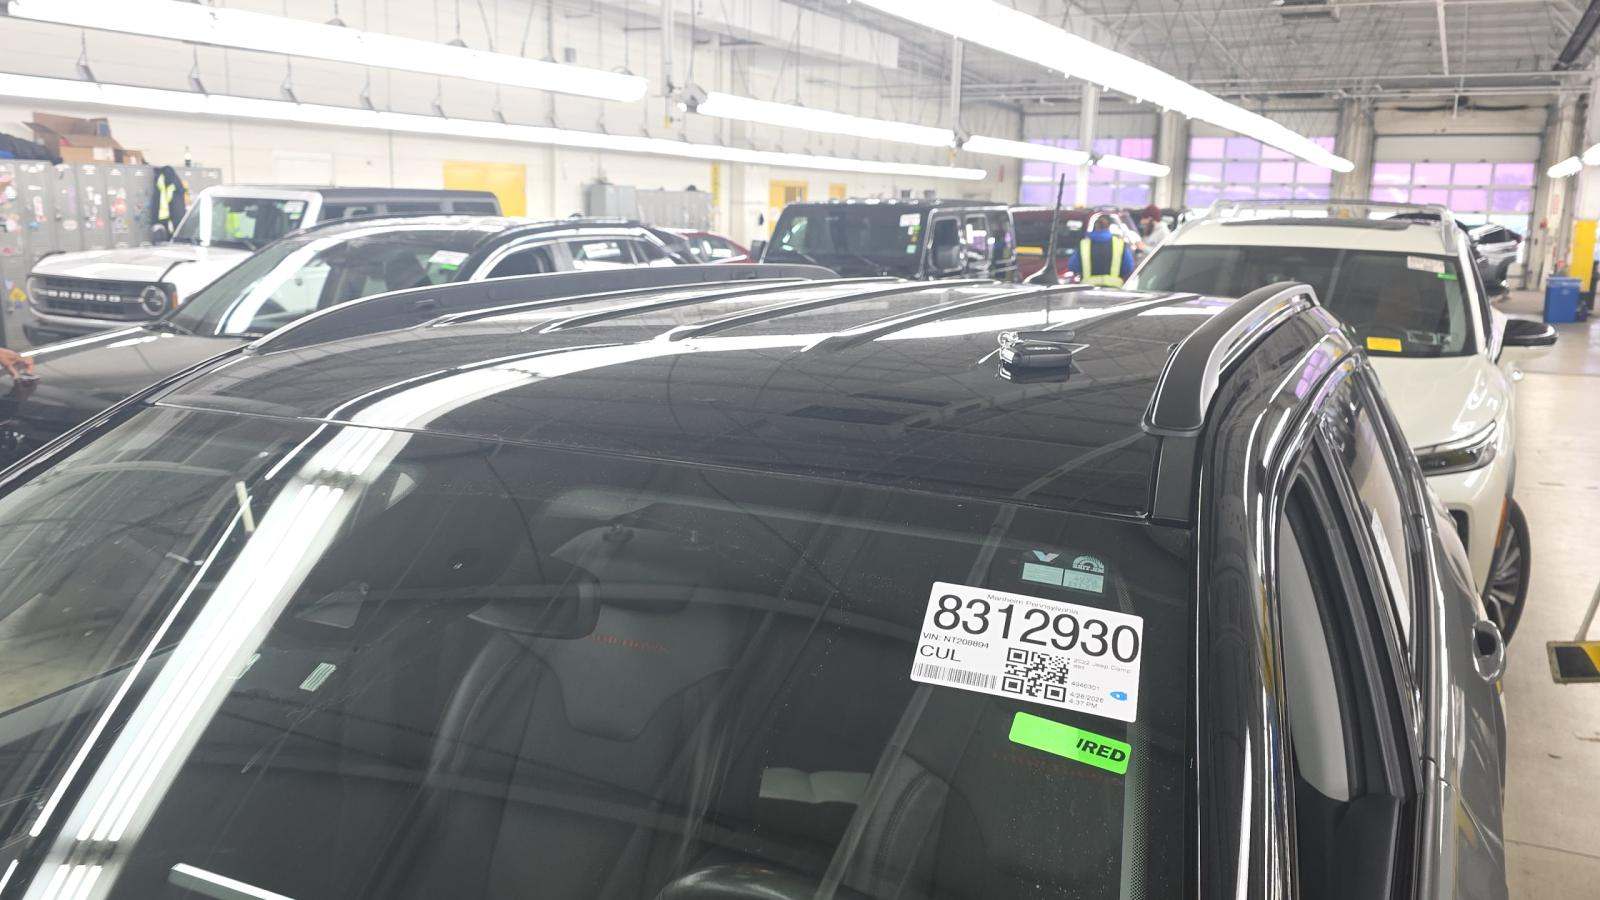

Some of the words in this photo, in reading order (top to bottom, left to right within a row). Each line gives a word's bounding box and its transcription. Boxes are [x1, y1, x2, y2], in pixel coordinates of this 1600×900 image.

[47, 289, 121, 303] BRONCO
[986, 593, 1024, 606] Manheim
[1025, 599, 1079, 615] Pennsylvania
[923, 631, 941, 641] VIN:
[933, 593, 1139, 663] 8312930
[920, 644, 962, 662] CUL
